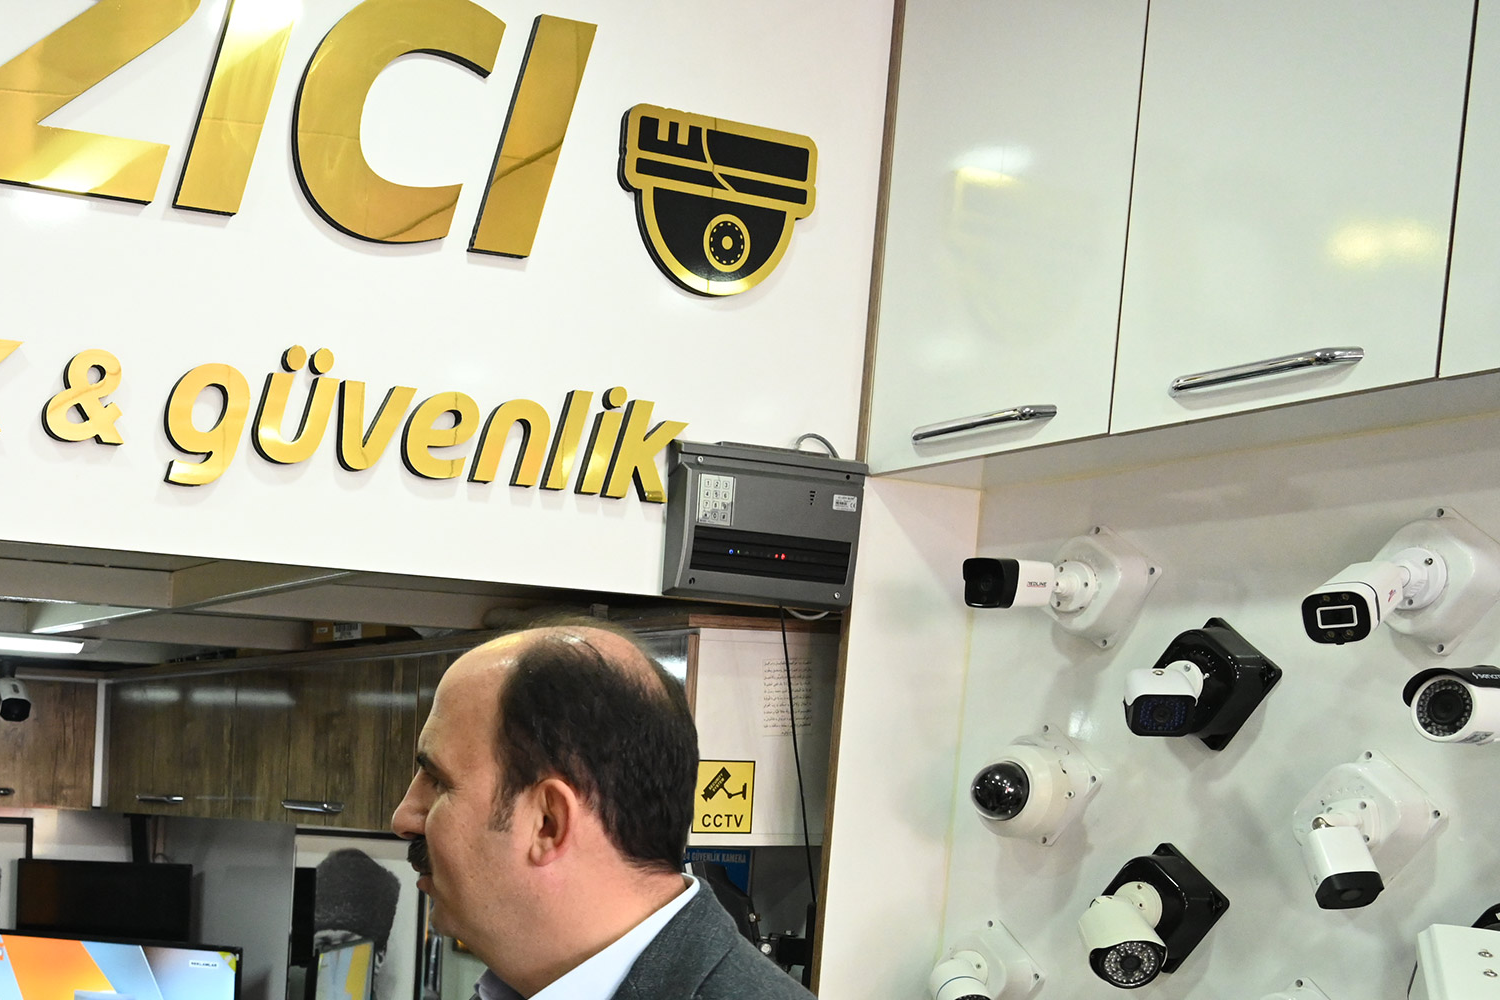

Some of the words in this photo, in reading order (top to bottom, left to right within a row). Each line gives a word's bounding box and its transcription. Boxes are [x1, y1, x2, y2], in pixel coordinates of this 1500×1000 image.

[41, 348, 124, 447] &
[163, 344, 689, 505] güvenlik
[708, 772, 724, 791] SECURITY
[712, 777, 725, 792] SYSTEM
[702, 813, 744, 828] CCTV
